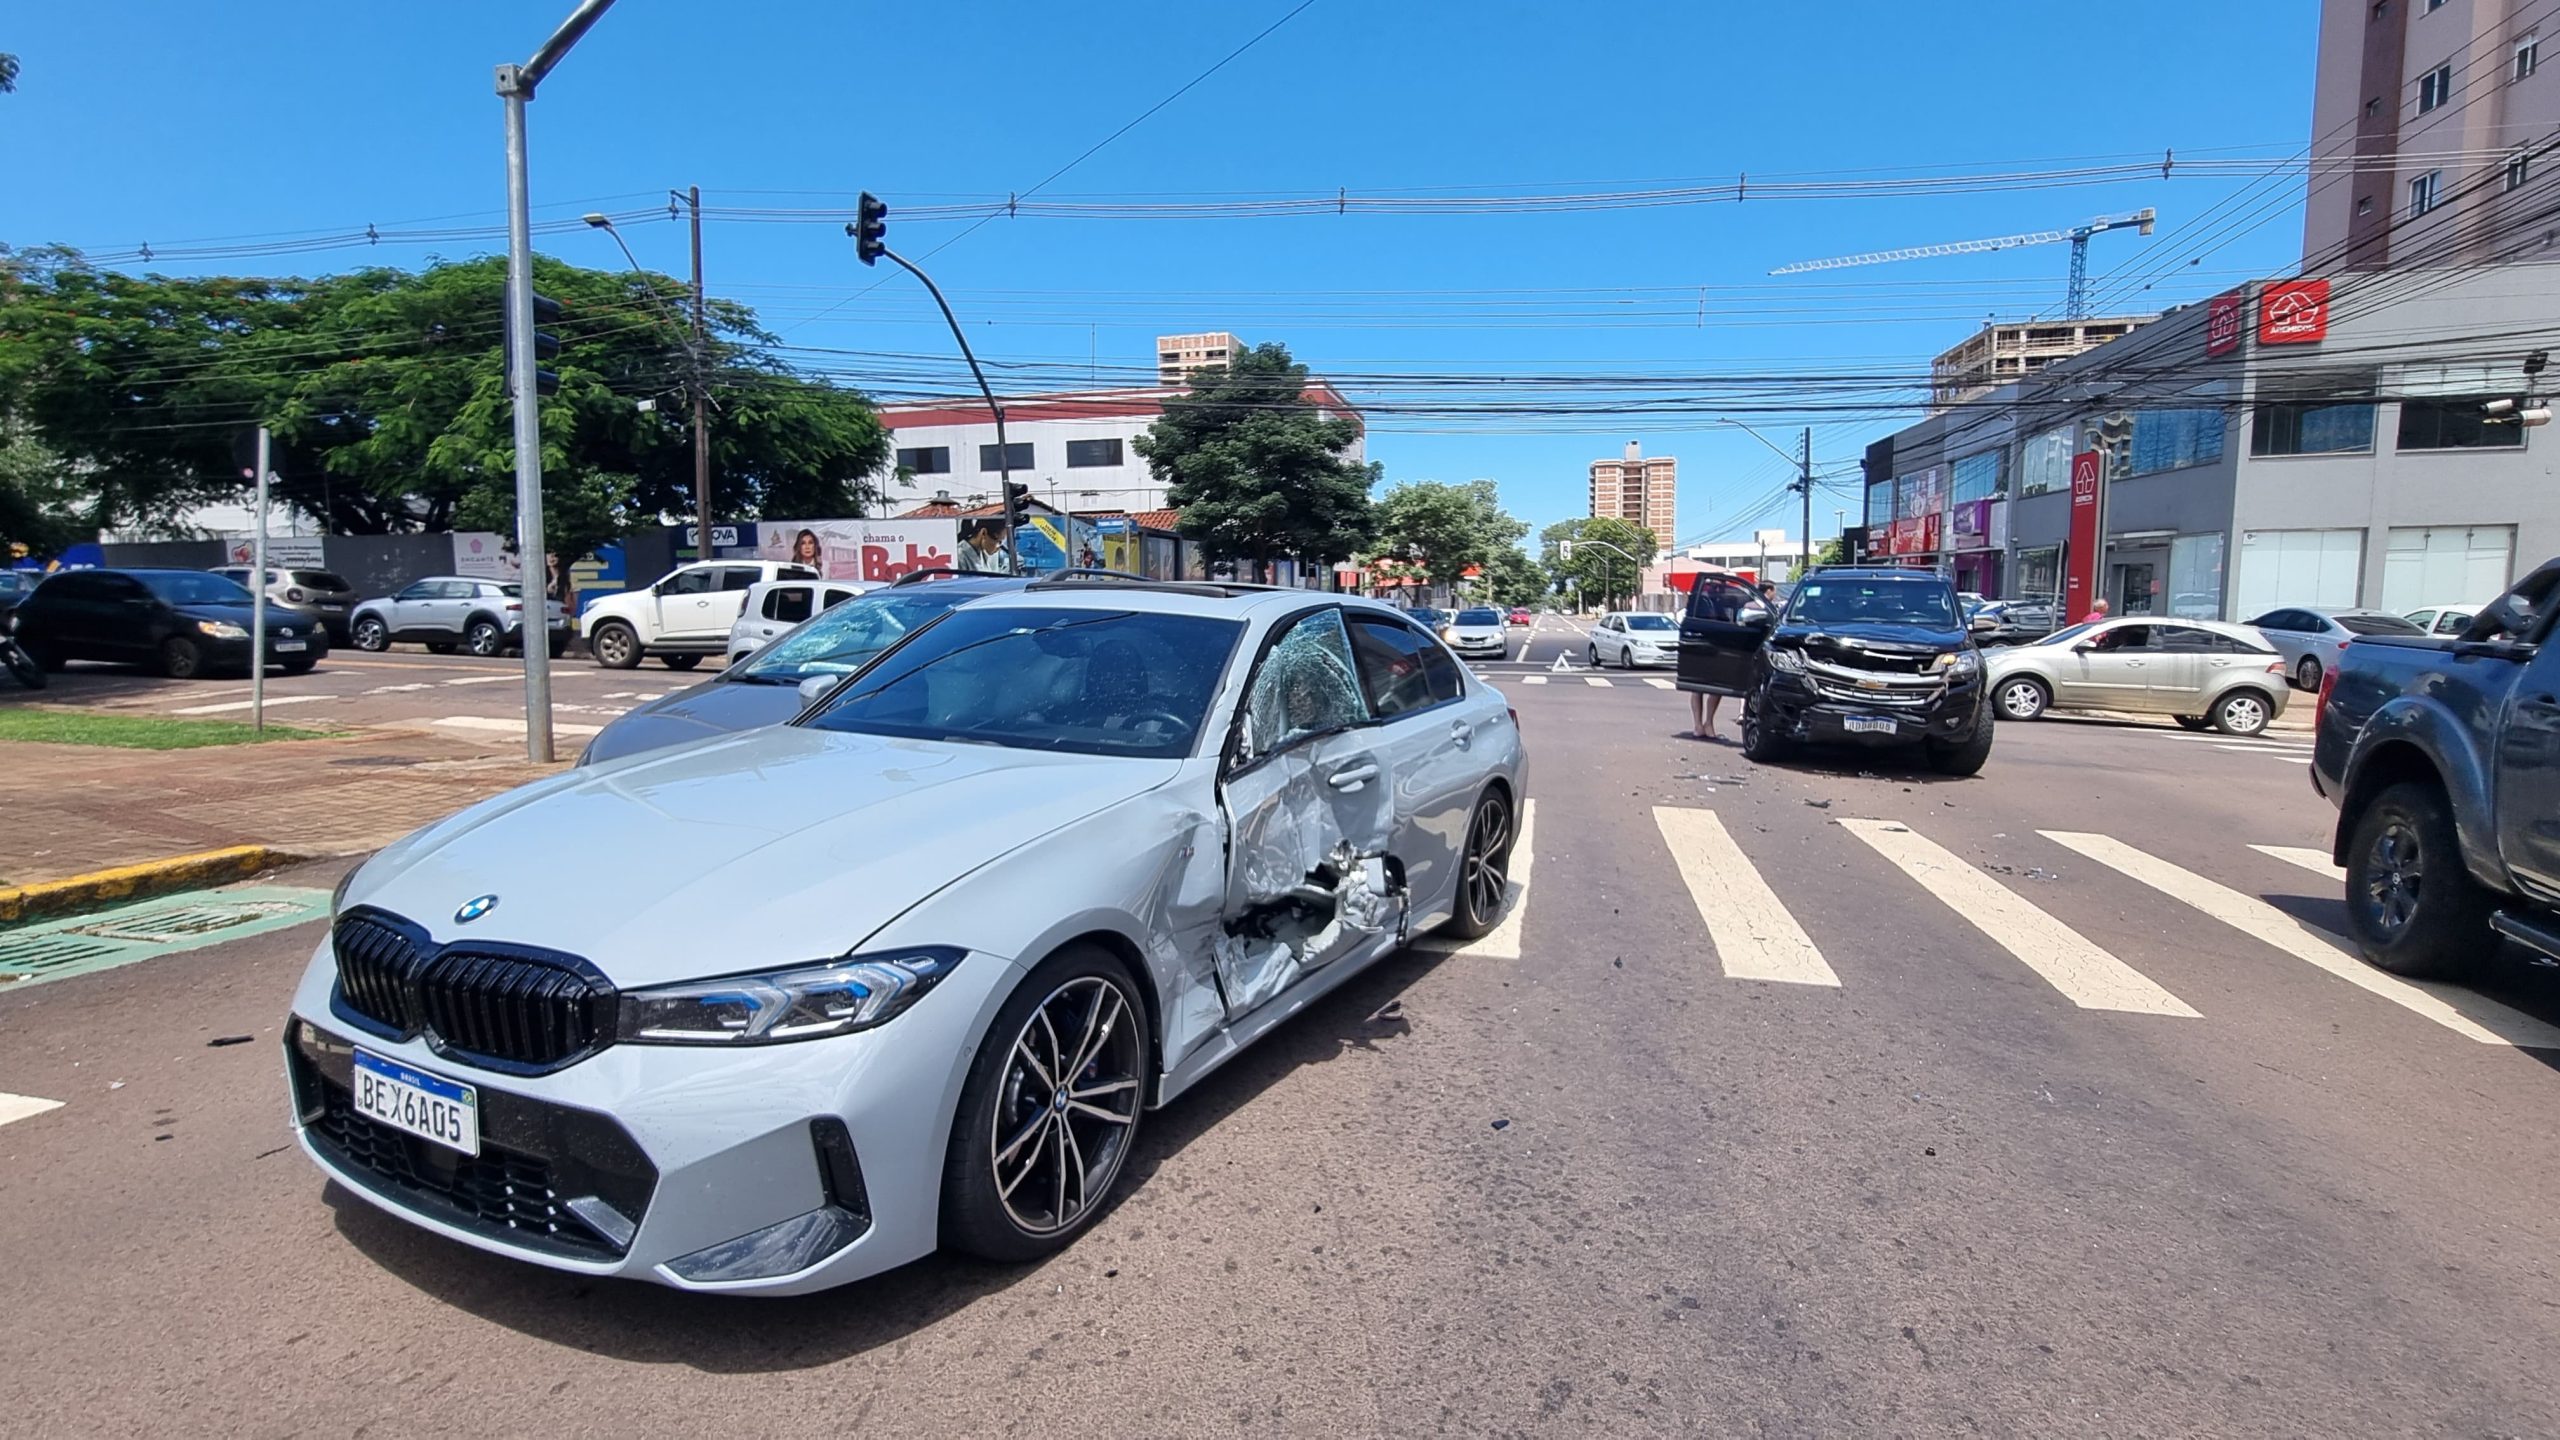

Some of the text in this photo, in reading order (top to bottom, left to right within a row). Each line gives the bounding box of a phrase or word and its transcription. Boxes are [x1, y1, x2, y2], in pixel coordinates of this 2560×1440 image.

[863, 533, 905, 543] chama o
[400, 1072, 420, 1086] BRASIL
[363, 1074, 461, 1142] BEX6A05
